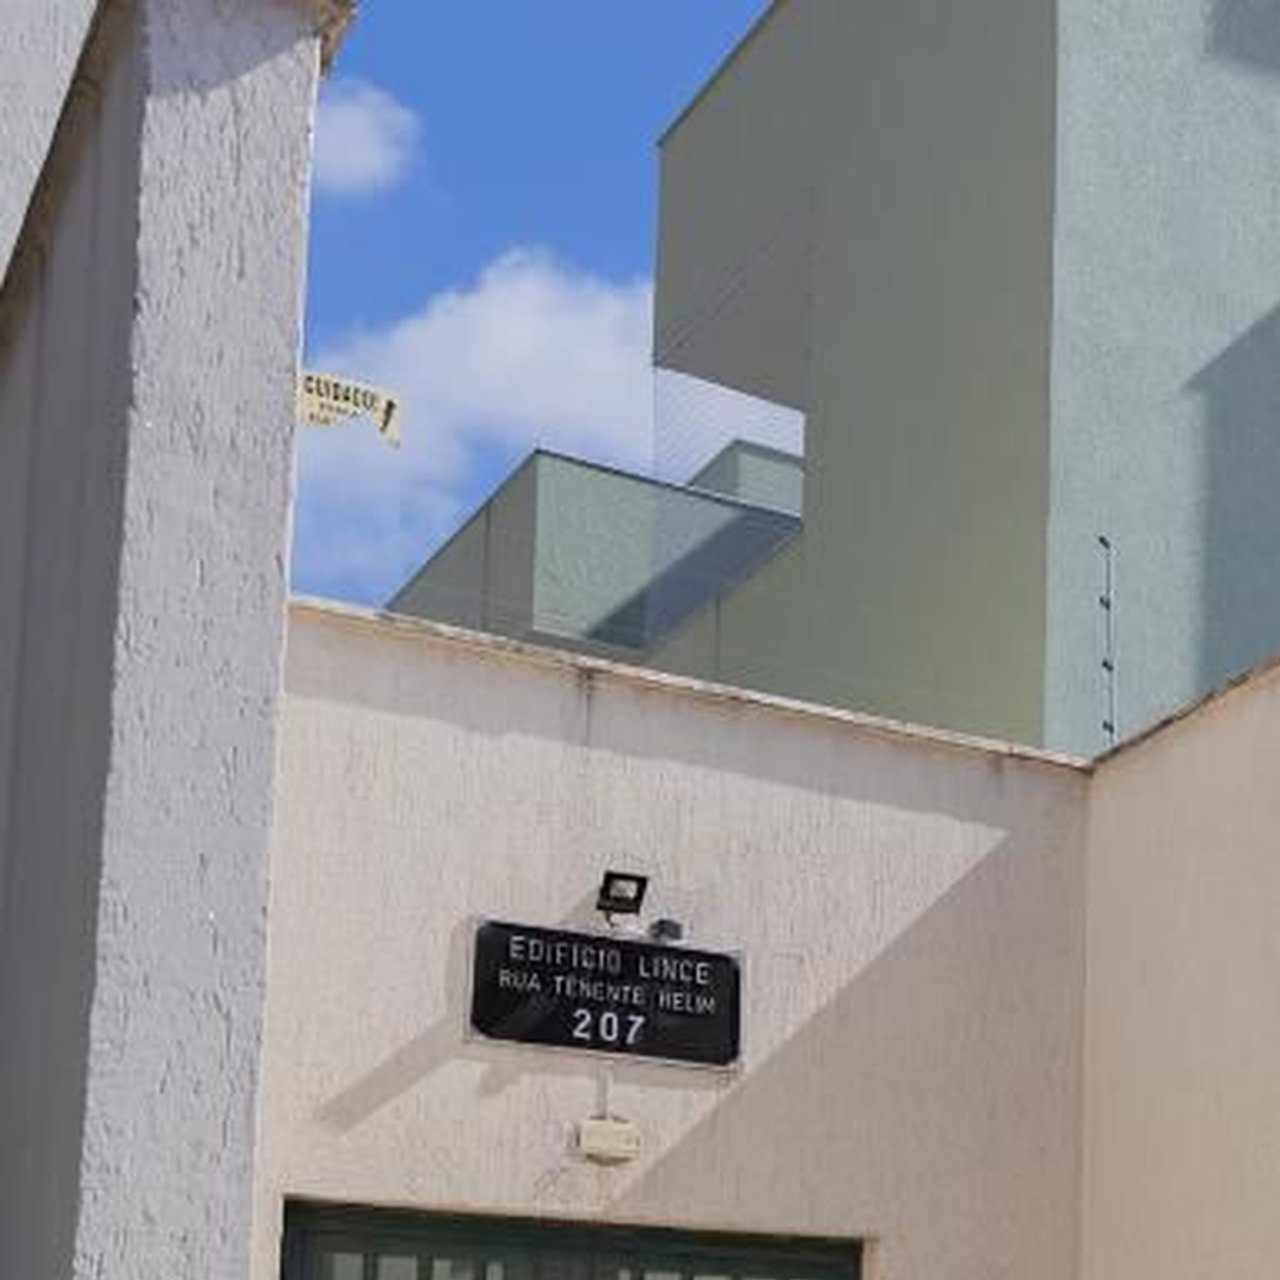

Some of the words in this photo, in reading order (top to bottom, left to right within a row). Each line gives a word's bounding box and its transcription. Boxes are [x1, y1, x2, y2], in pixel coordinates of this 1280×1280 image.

[499, 969, 542, 992] RUA
[553, 974, 645, 1005] TENENTE
[638, 956, 712, 984] LINCE
[572, 1008, 645, 1044] 207
